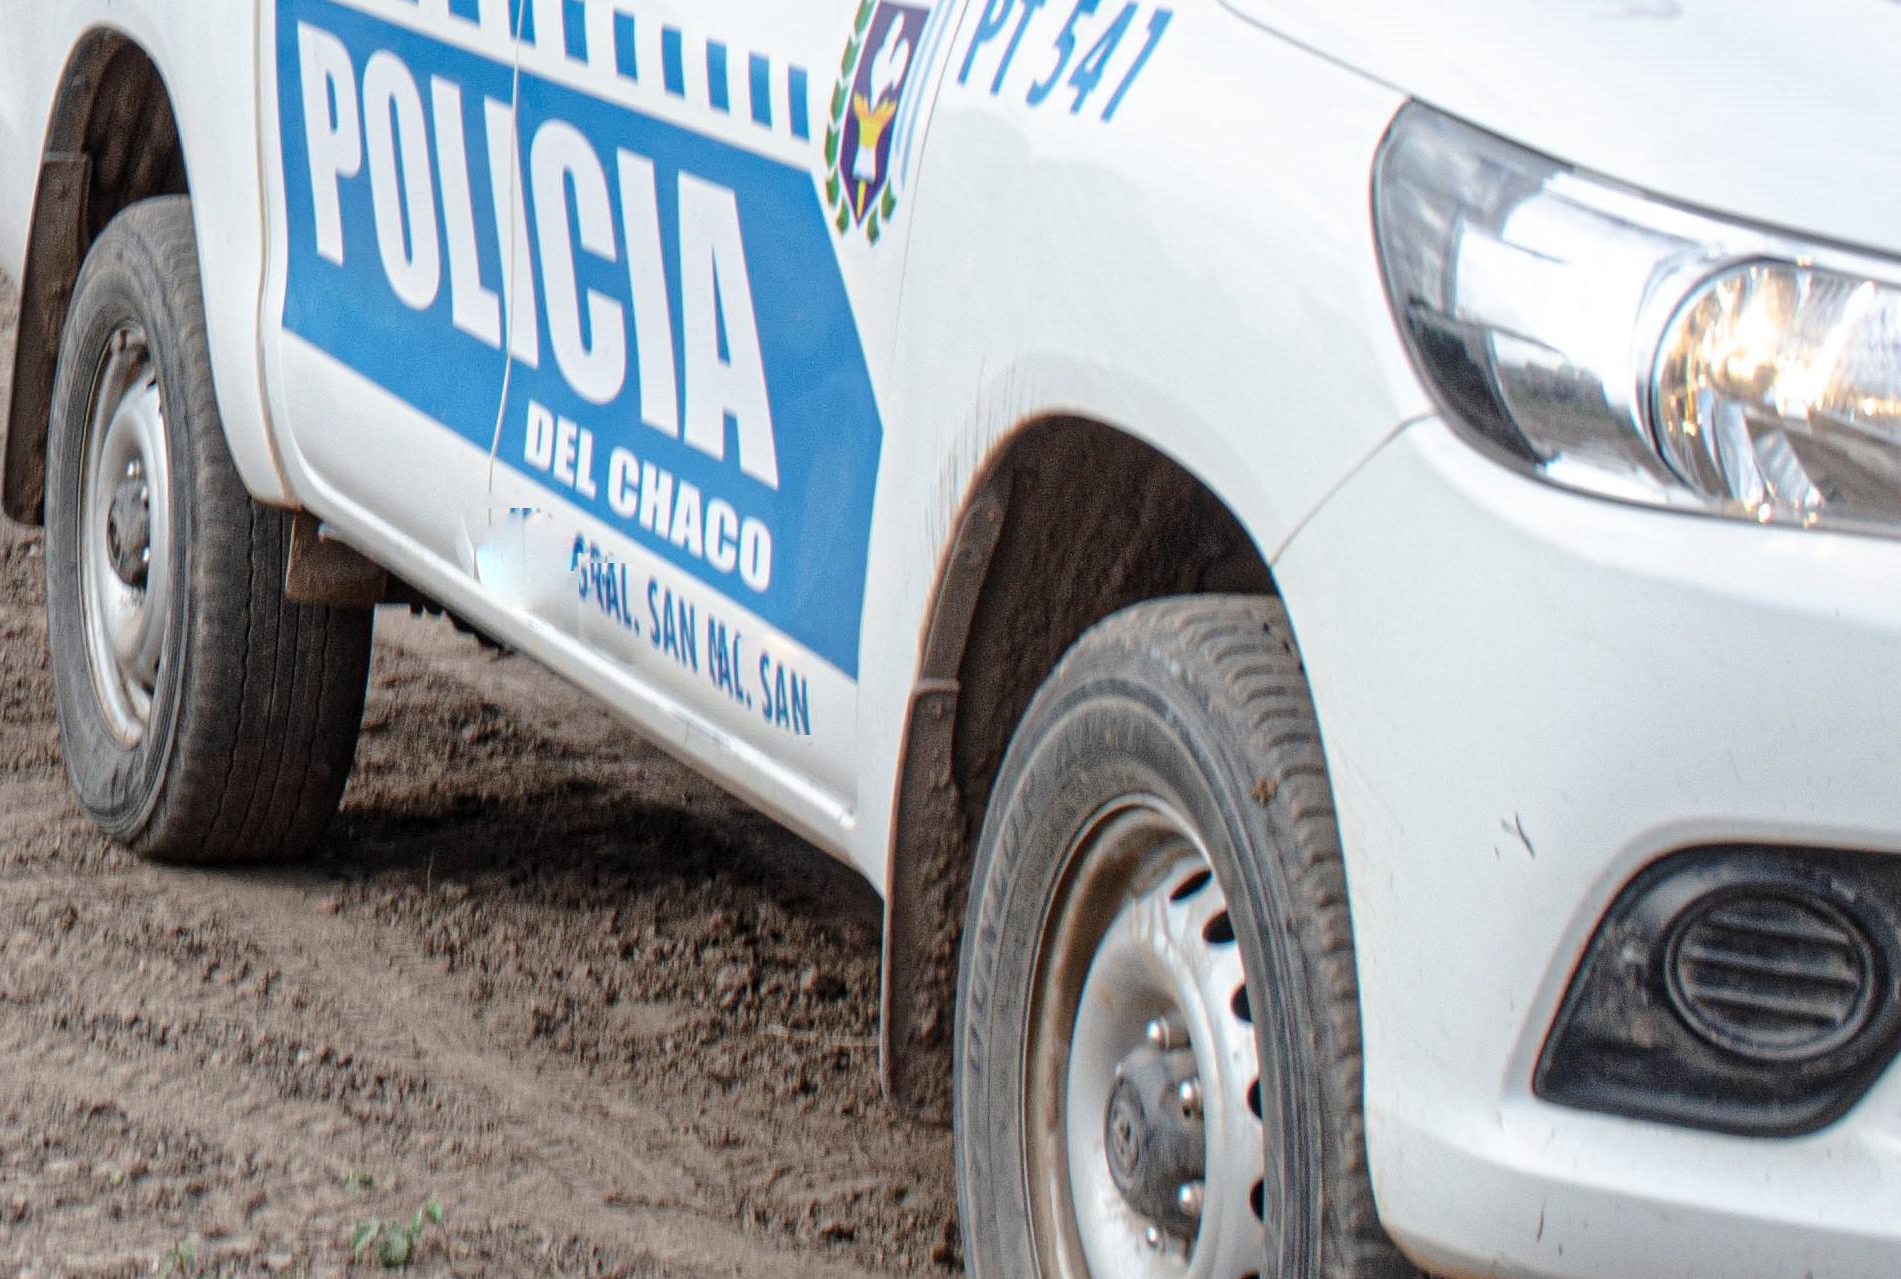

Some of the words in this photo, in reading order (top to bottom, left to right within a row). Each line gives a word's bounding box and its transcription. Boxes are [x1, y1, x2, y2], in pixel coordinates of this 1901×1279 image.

[297, 19, 780, 492] POLICIA
[523, 398, 597, 502] DEL
[607, 446, 772, 594] CHACO
[648, 577, 698, 674] SAN
[760, 650, 812, 736] SAN
